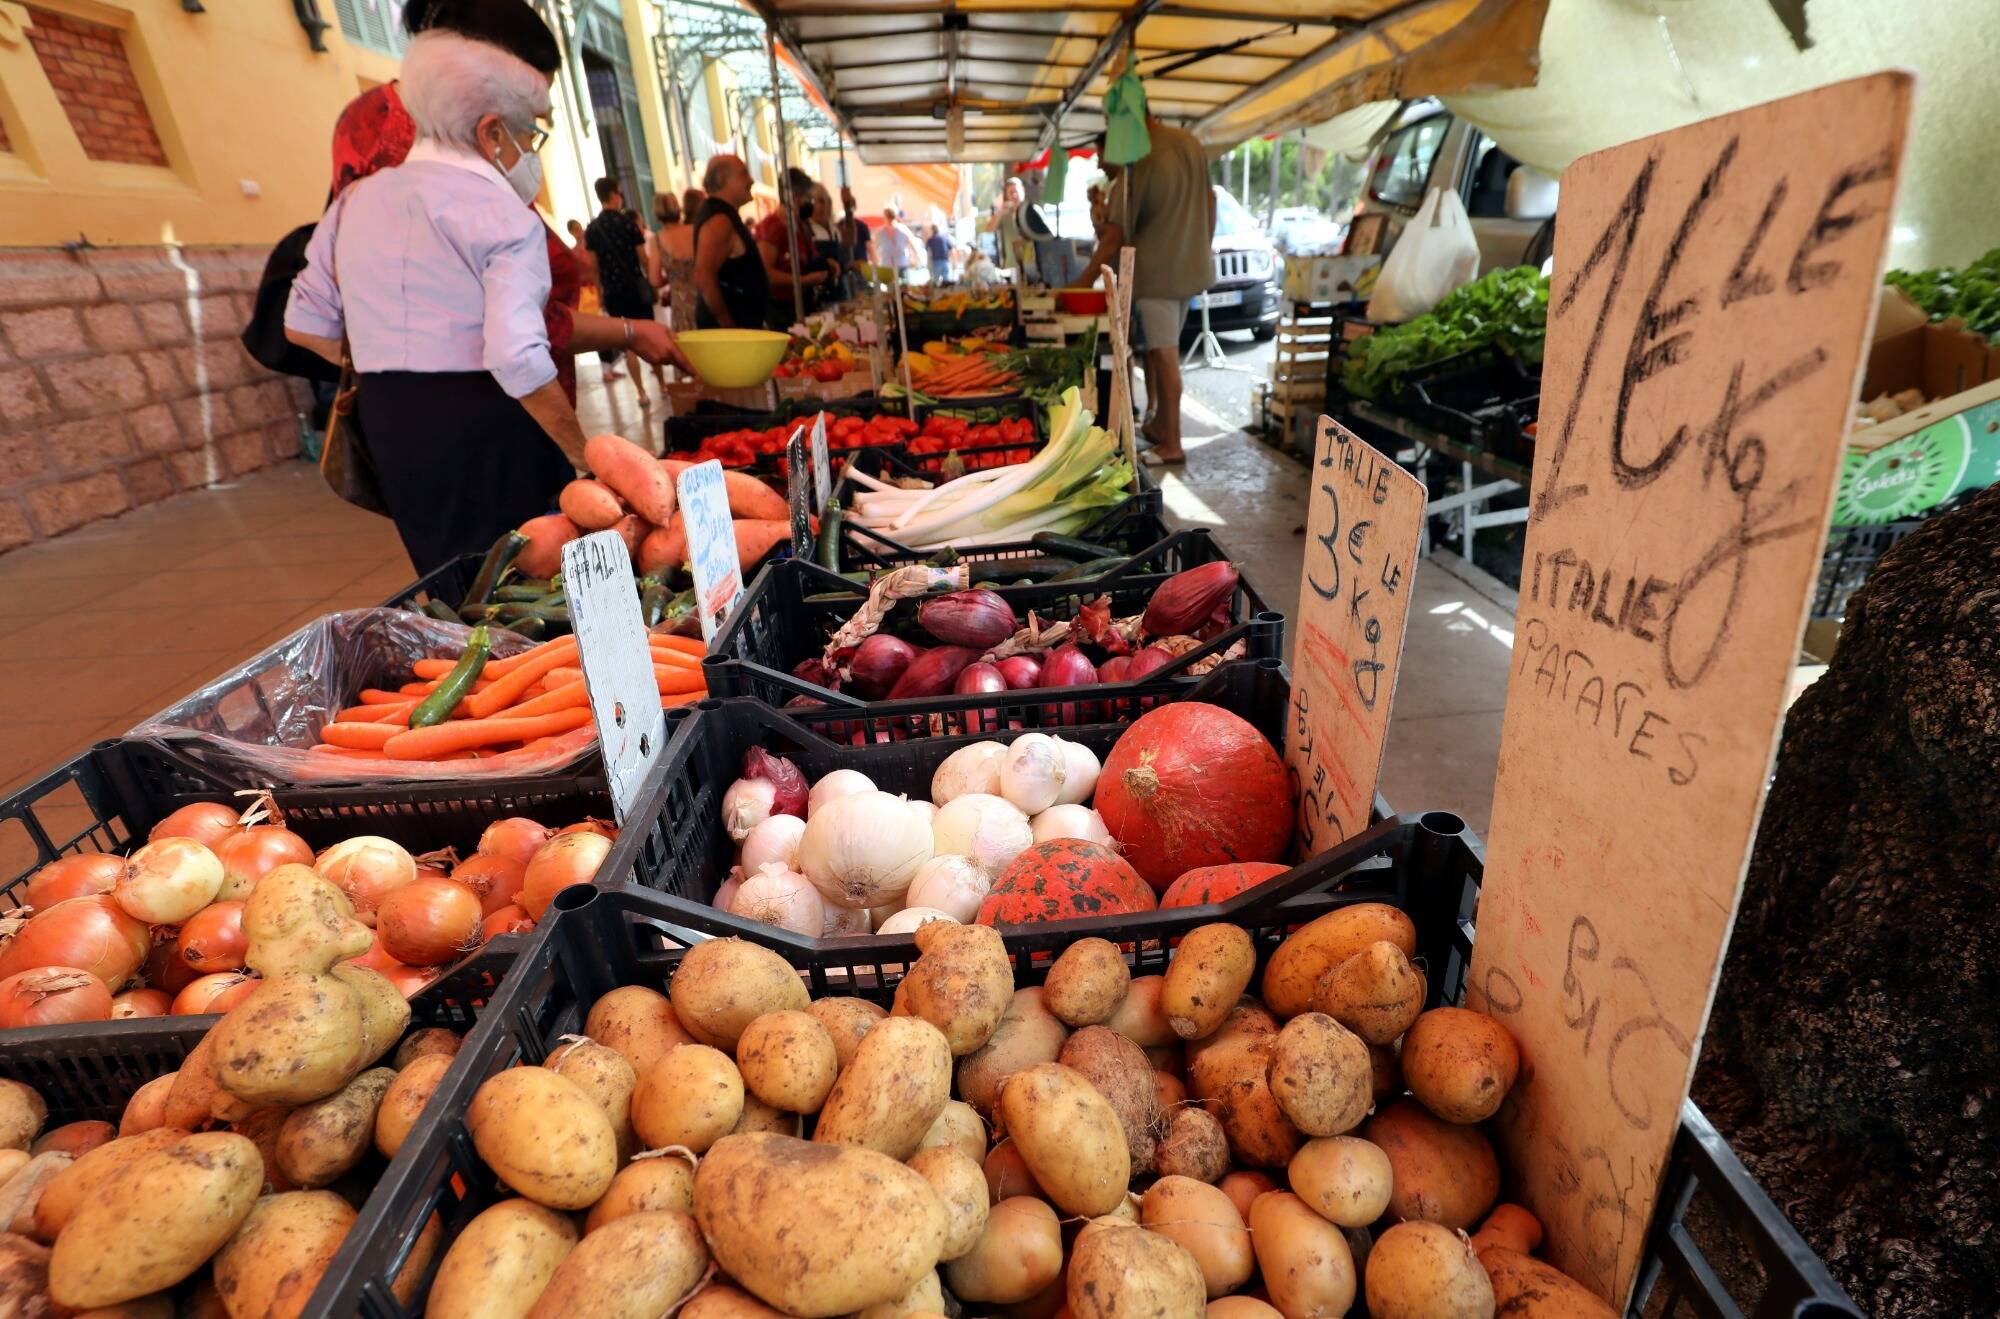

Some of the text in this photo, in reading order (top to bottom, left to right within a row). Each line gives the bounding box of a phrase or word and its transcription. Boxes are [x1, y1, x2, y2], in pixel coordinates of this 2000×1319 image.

[1321, 426, 1391, 505] ITALIE
[1532, 547, 1672, 643] ITALIE
[1518, 616, 1708, 786] PATATES
